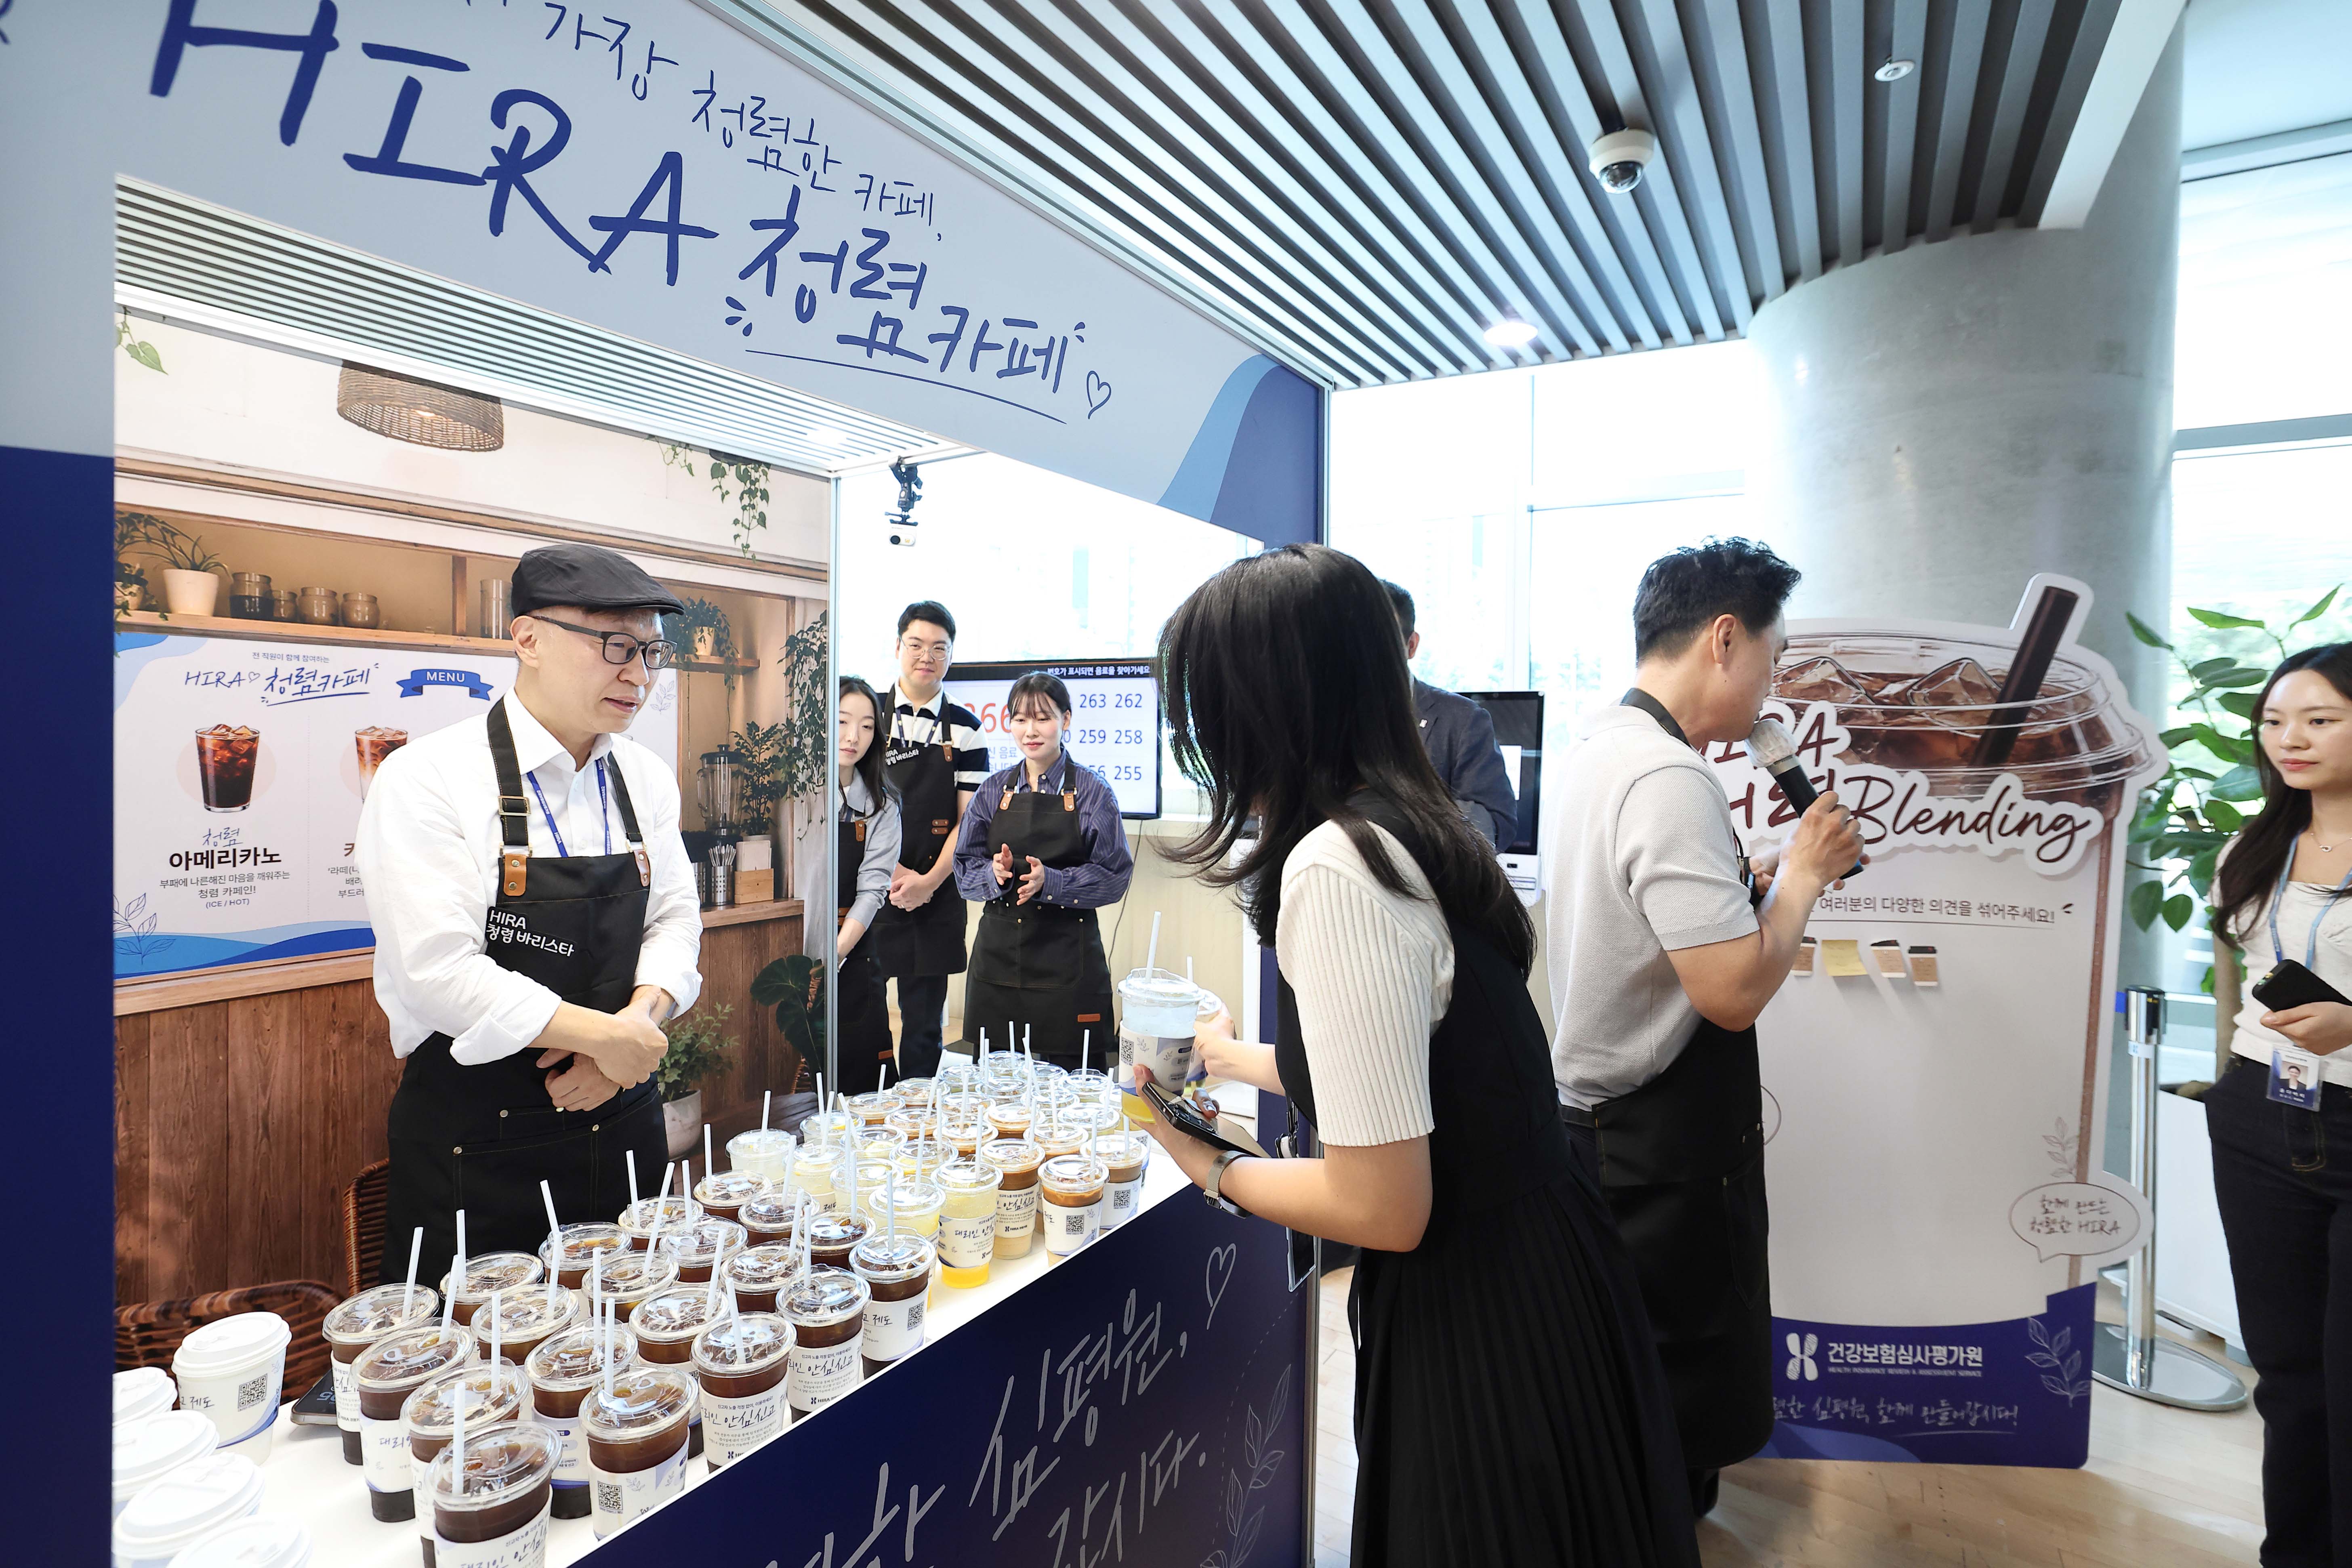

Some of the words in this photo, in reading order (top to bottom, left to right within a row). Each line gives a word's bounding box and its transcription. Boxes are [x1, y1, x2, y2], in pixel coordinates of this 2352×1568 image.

[544, 3, 679, 100] 가장
[692, 70, 842, 192] 청렴한
[855, 173, 942, 241] 카페,
[149, 0, 719, 286] HIRA
[739, 185, 1069, 393] 청렴카페
[252, 652, 260, 660] 전
[262, 652, 284, 661] 직원이
[286, 654, 300, 662] 함께
[302, 654, 330, 663] 참여하는
[426, 671, 466, 683] MENU
[1068, 666, 1094, 676] 표시되면
[1117, 666, 1151, 675] 찾아가세요
[185, 671, 246, 688] HIRA
[264, 667, 370, 696] 청렴카페
[1080, 694, 1106, 708] 263
[1116, 693, 1143, 708] 262
[965, 703, 1011, 733] 66
[1079, 730, 1106, 744] 259
[1115, 730, 1143, 744] 258
[896, 748, 919, 761] 바리스타
[999, 746, 1017, 759] 음료
[1114, 766, 1142, 780] 255
[1844, 775, 2091, 862] Blending
[202, 827, 243, 847] 청렴
[169, 847, 282, 871] 아메리카노
[160, 878, 188, 889] 부패에
[190, 874, 226, 886] 나른해진
[229, 872, 255, 883] 마음을
[257, 871, 290, 881] 깨워주는
[198, 889, 219, 898] 청렴
[223, 885, 256, 896] 카페인!
[338, 887, 364, 898] 부드러
[206, 900, 222, 909] (ICE
[1819, 896, 1876, 912] 여러분의
[1881, 897, 1925, 913] 다양한
[1929, 899, 1973, 917] 의견을
[1978, 902, 2055, 923] 섞어주세요!
[489, 910, 526, 929] HIRA
[486, 923, 514, 944] 청렴
[516, 931, 574, 956] 바리스타
[1003, 1196, 1035, 1211] 안심신고
[954, 1229, 981, 1239] 대리인
[2030, 1216, 2072, 1235] 청렴한
[2078, 1220, 2121, 1235] HIRA
[872, 1314, 893, 1326] 제도
[1828, 1343, 1983, 1367] 건강보험심사평가원
[788, 1358, 805, 1374] 리인
[808, 1355, 853, 1377] 안심신고
[189, 1396, 215, 1410] 제도
[755, 1396, 773, 1406] 이용하세요!
[1772, 1395, 1806, 1420] 렴한
[1812, 1396, 1869, 1424] 심평원,
[1877, 1397, 1913, 1424] 함께
[701, 1403, 722, 1426] 리인
[725, 1404, 776, 1429] 안심신고
[969, 1288, 1188, 1542] 심평원,
